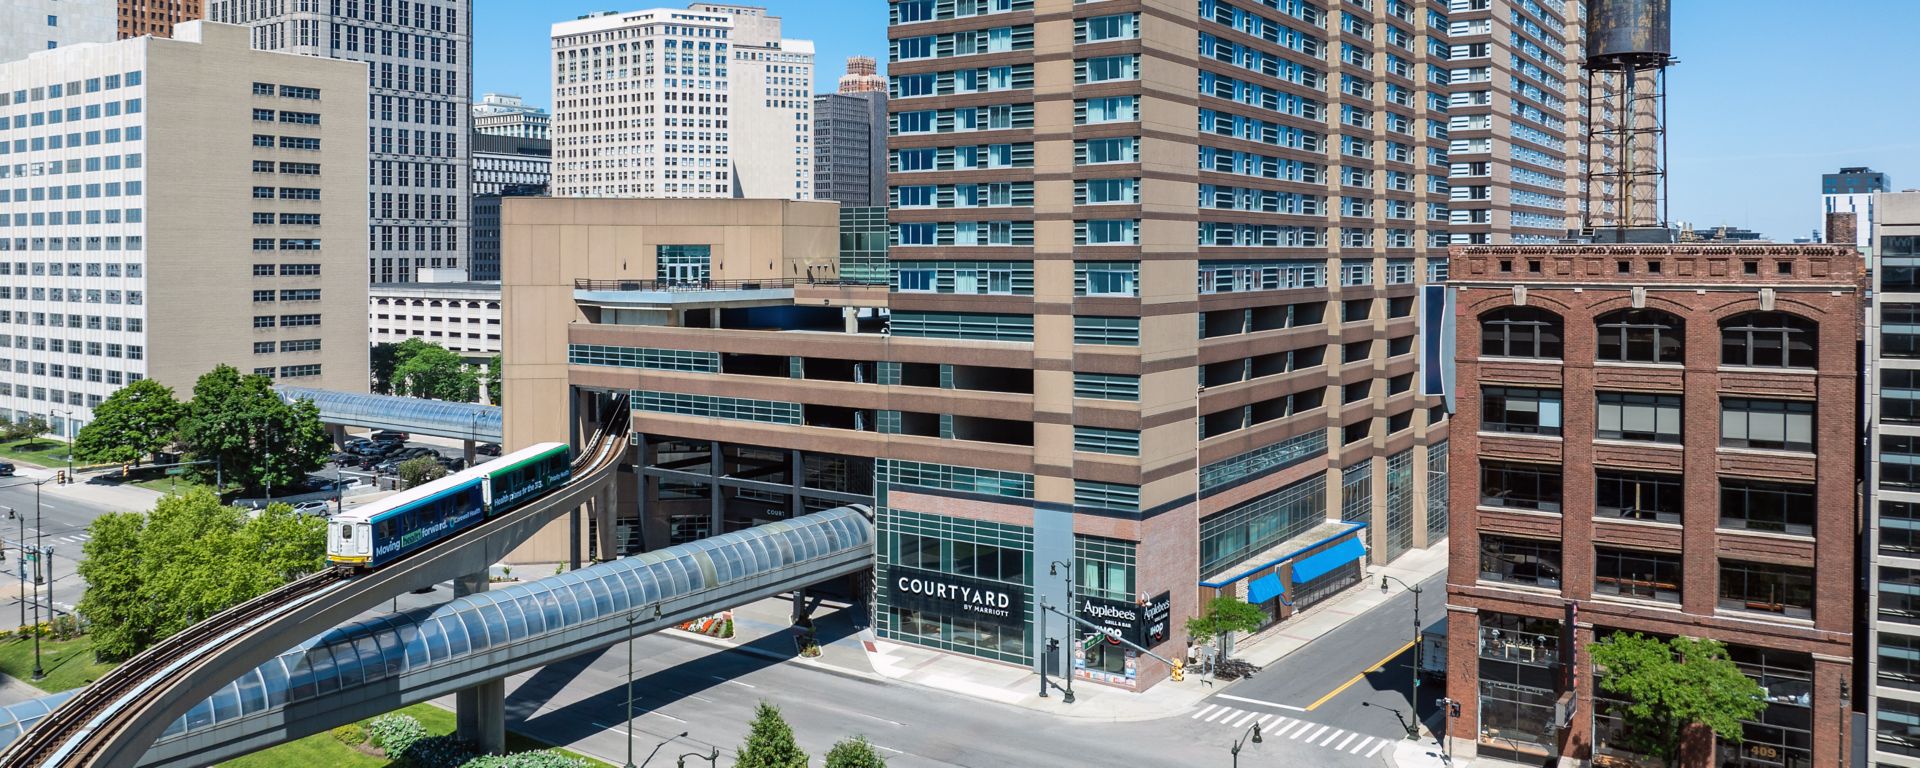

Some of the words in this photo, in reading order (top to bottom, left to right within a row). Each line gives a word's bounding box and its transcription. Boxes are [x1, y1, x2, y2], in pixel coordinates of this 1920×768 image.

[494, 494, 509, 506] Health
[376, 540, 400, 556] Moving
[898, 577, 1009, 608] COURTYARD
[974, 606, 1009, 616] MARRIOTT
[1084, 600, 1136, 620] Applebee's
[1150, 622, 1163, 636] IHOP
[1751, 746, 1776, 758] 409
